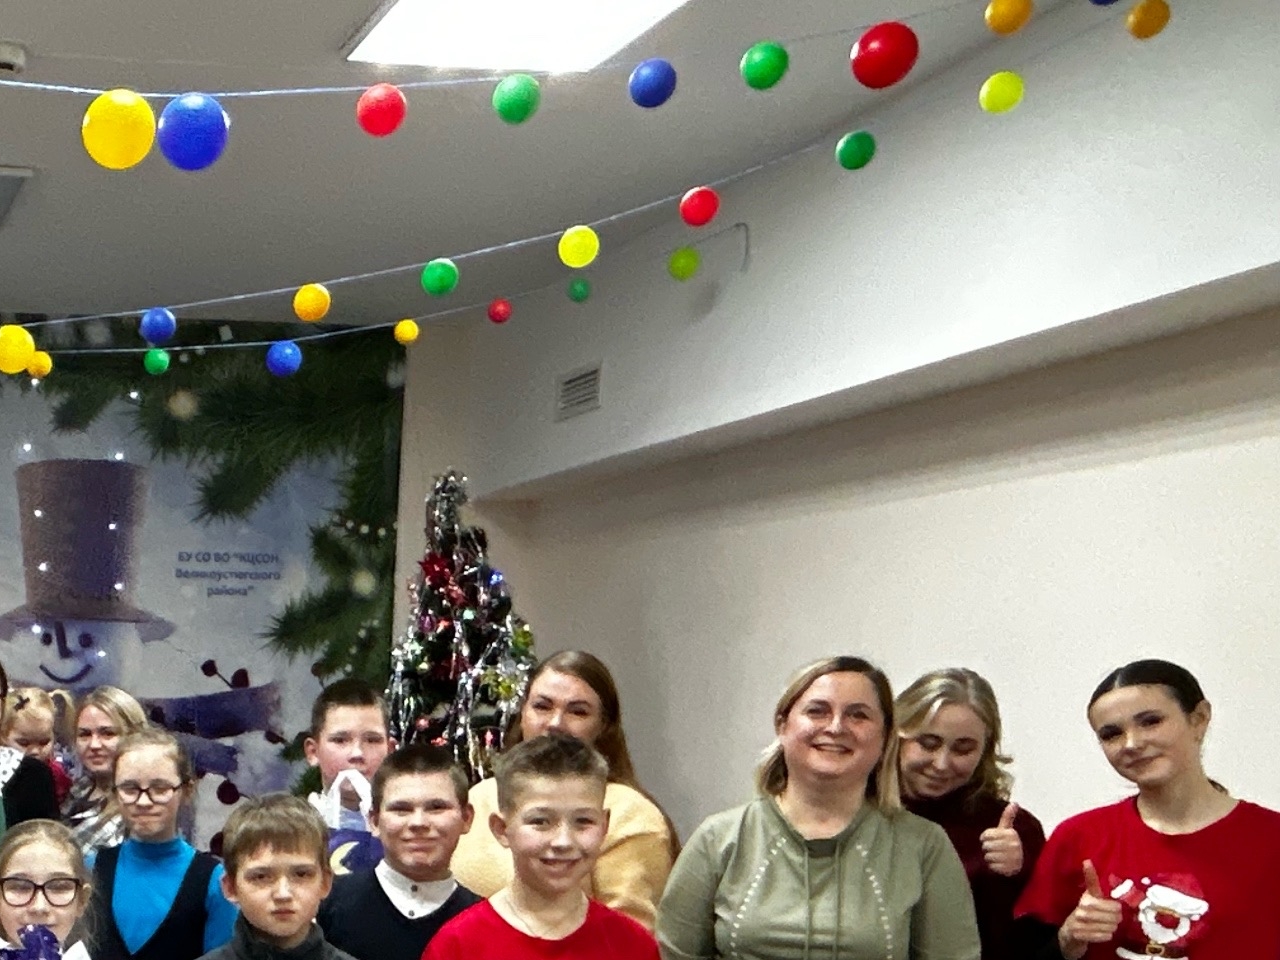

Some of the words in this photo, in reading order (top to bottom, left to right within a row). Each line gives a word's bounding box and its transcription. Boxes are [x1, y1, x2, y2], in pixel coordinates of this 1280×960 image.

[178, 551, 193, 563] БУ
[195, 551, 211, 563] СО
[214, 552, 230, 563] ВО
